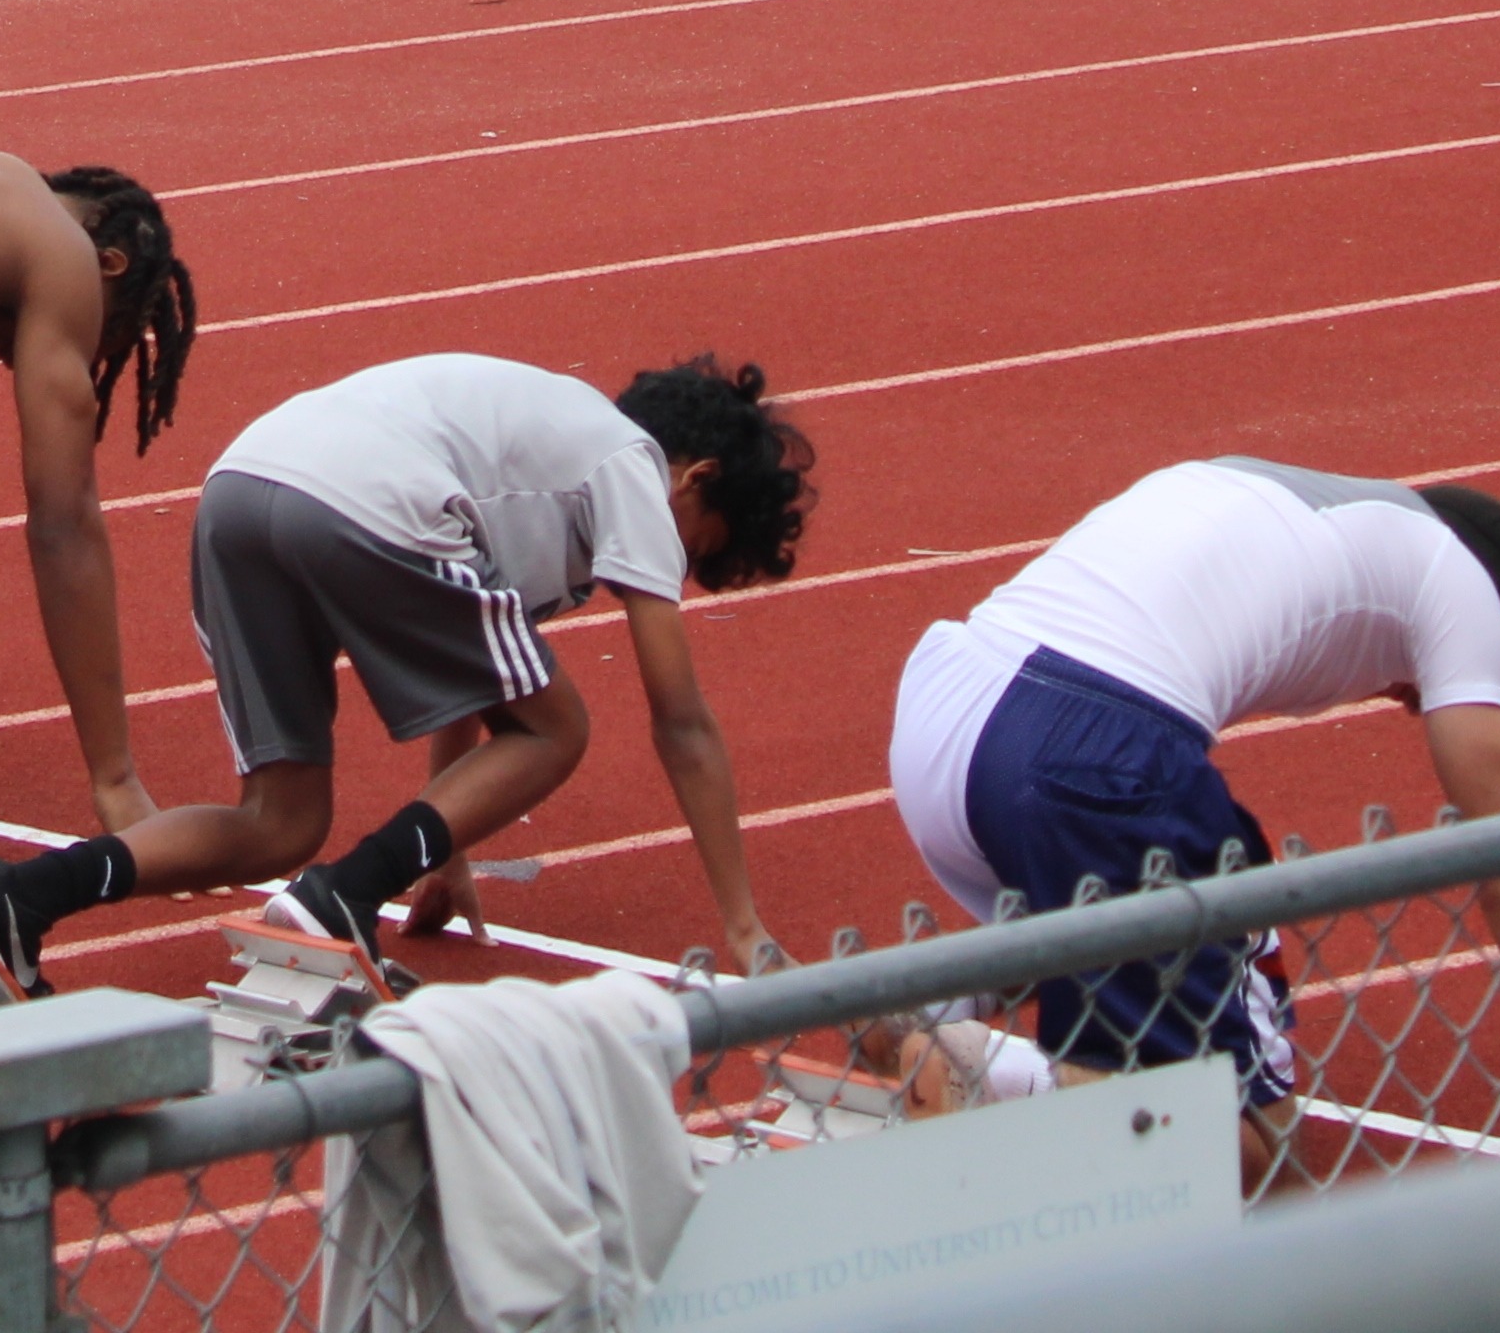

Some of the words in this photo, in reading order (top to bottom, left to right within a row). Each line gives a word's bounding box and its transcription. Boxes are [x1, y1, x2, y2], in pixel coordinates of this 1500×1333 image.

[647, 1271, 799, 1328] WELCOME
[807, 1257, 849, 1295] TO
[856, 1217, 1026, 1285] UNIVERSITY
[1033, 1202, 1098, 1243] CITY
[1109, 1182, 1192, 1224] HIGH
